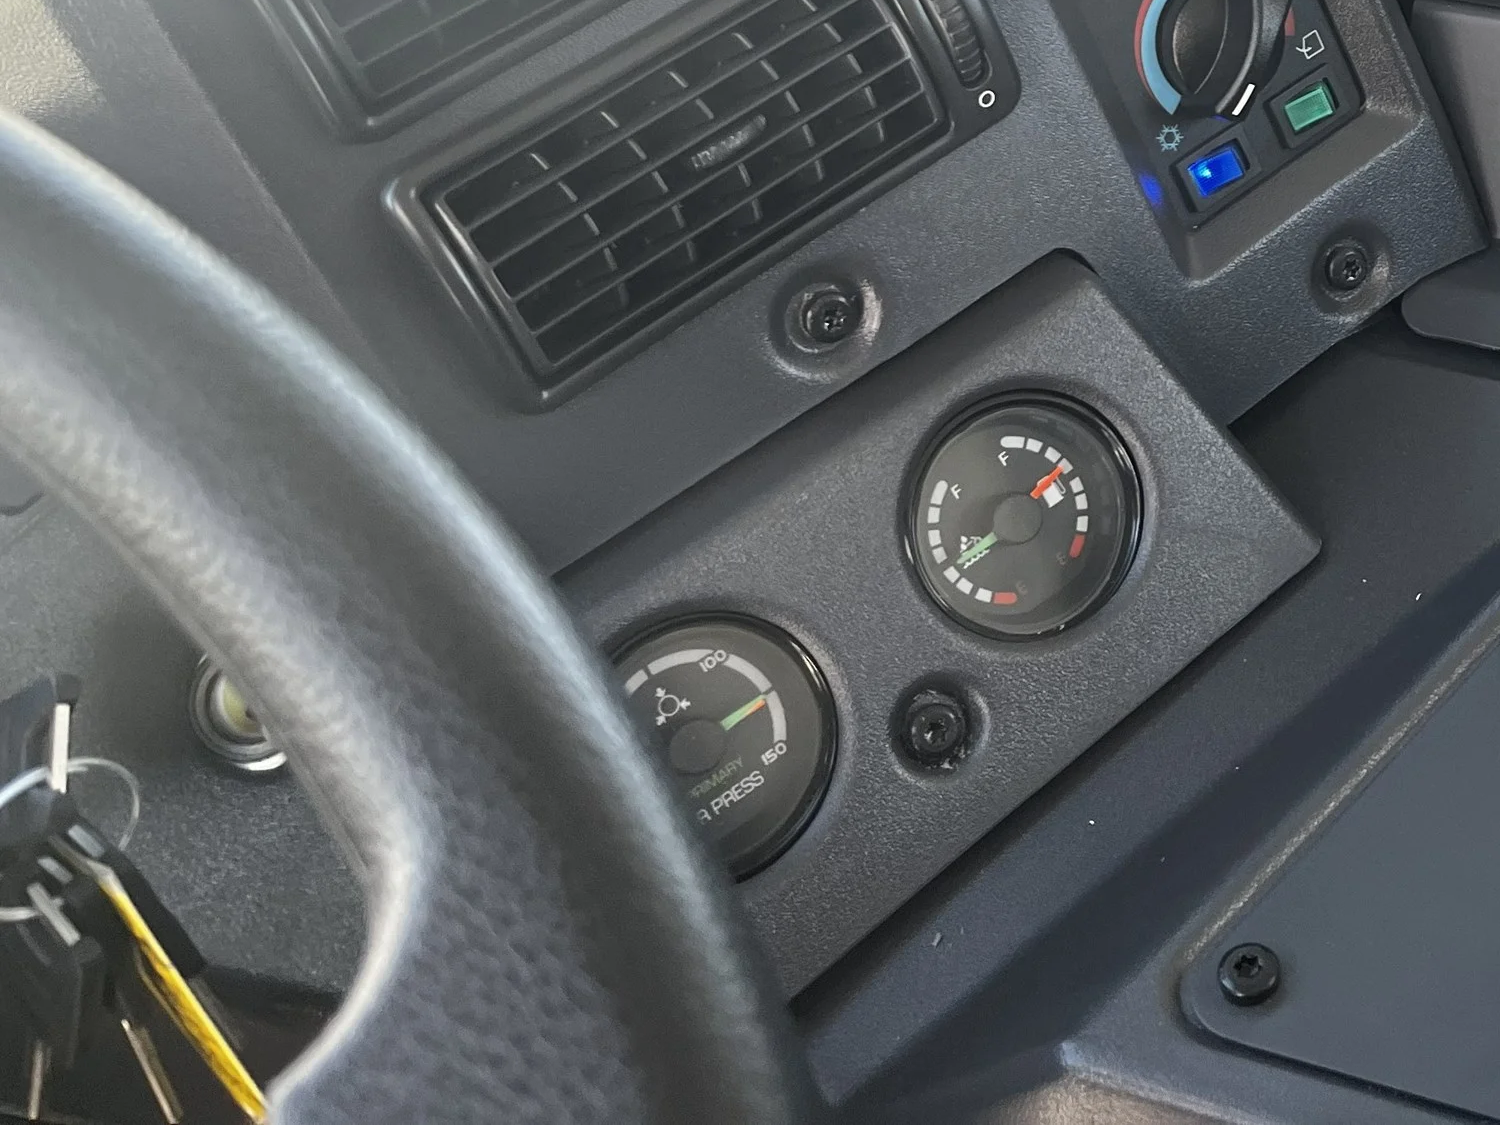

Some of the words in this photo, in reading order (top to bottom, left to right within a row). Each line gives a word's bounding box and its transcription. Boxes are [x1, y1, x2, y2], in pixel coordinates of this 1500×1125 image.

[997, 450, 1010, 467] F
[950, 483, 962, 500] F
[699, 649, 727, 673] 100
[760, 742, 787, 766] 150
[710, 770, 765, 815] PRESS
